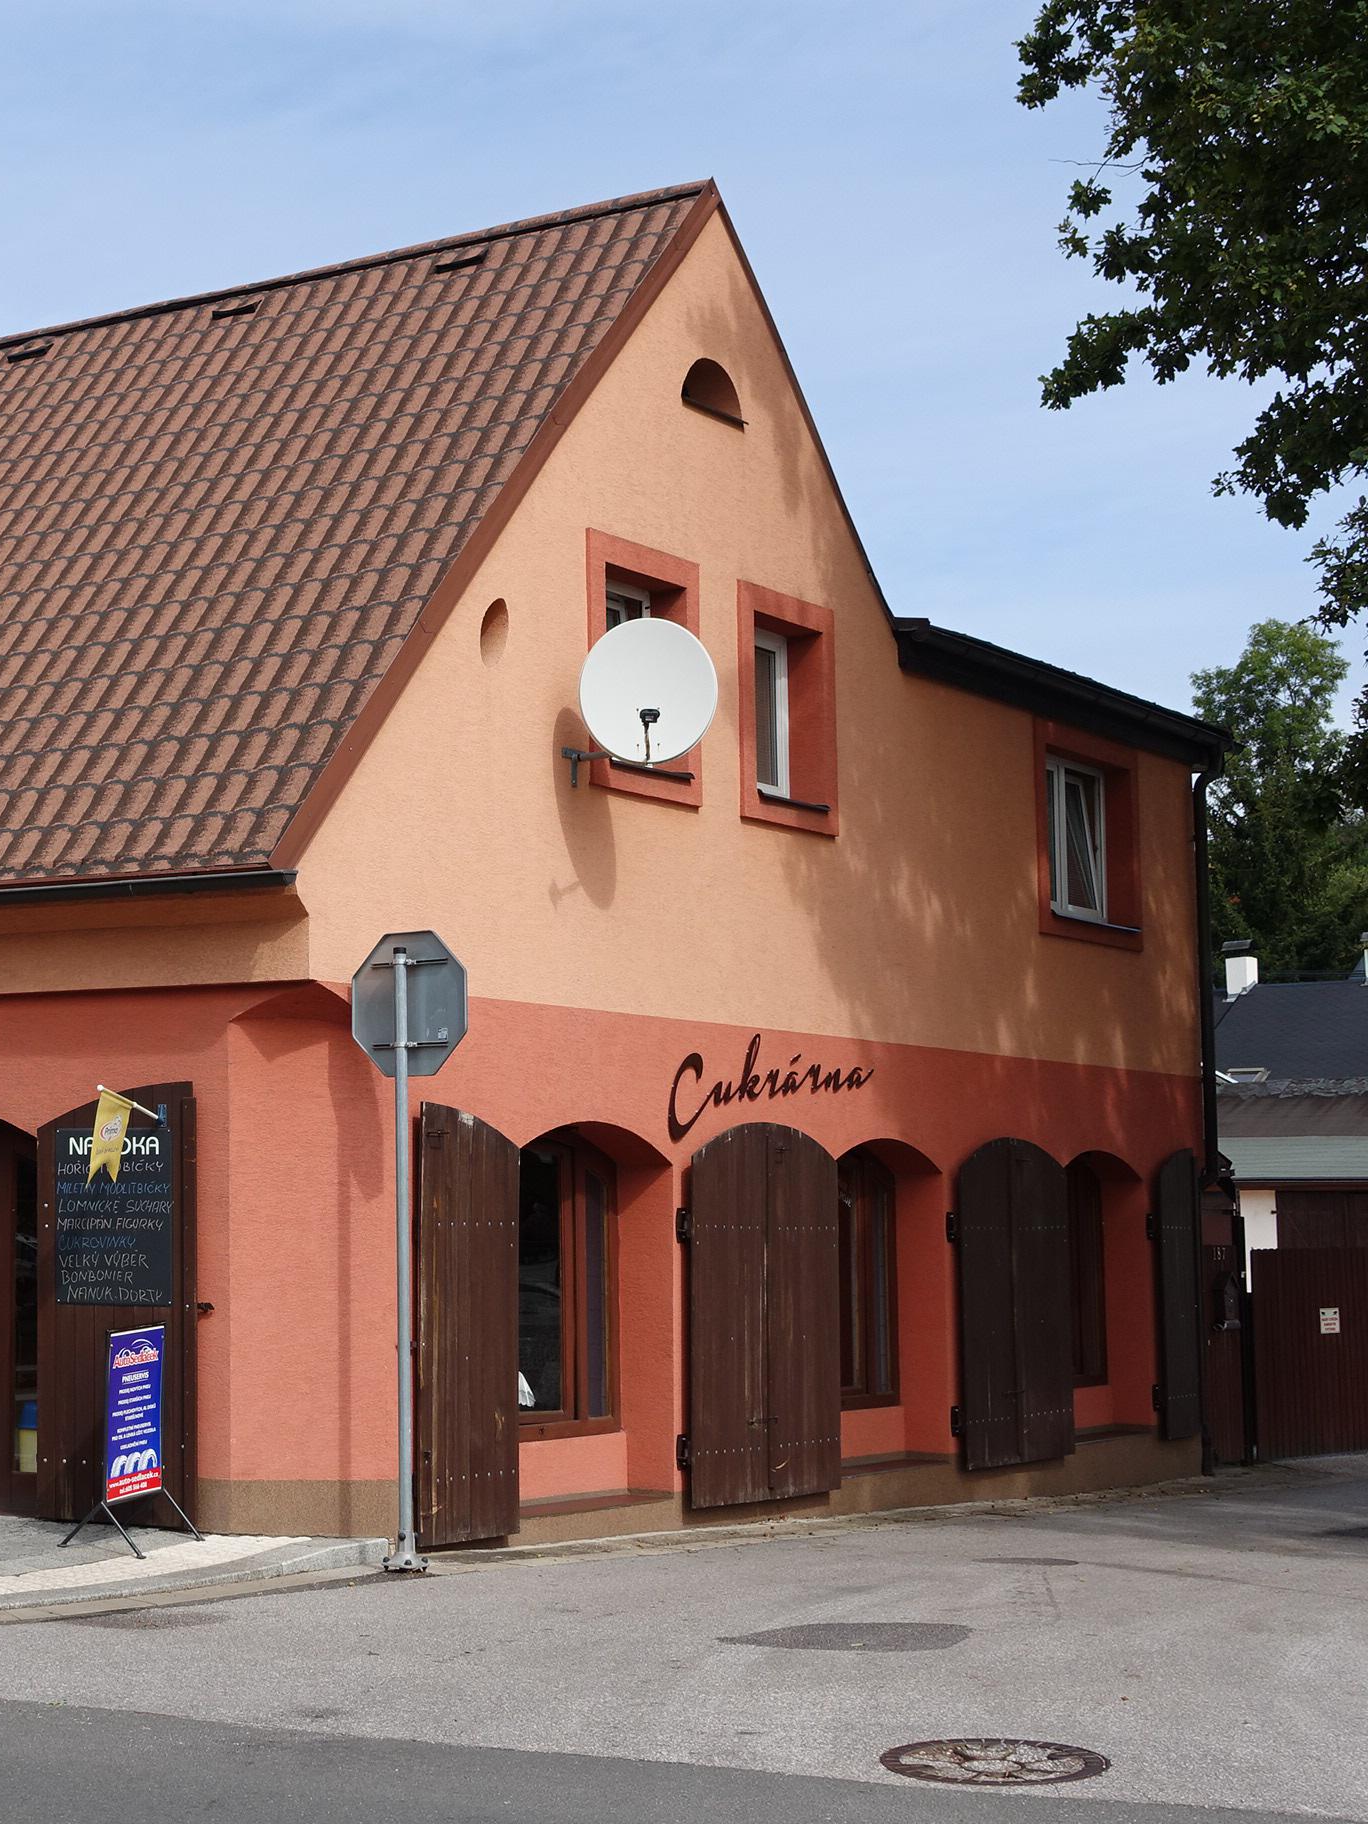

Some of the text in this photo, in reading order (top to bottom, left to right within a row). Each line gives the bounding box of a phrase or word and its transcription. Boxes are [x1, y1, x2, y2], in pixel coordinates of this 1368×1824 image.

[667, 1033, 874, 1144] Cukrárna
[69, 1136, 160, 1155] NADKA
[126, 1200, 174, 1214] SUCHARY
[115, 1217, 164, 1231] FIGURKY
[57, 1235, 136, 1250] CUKROVINKY
